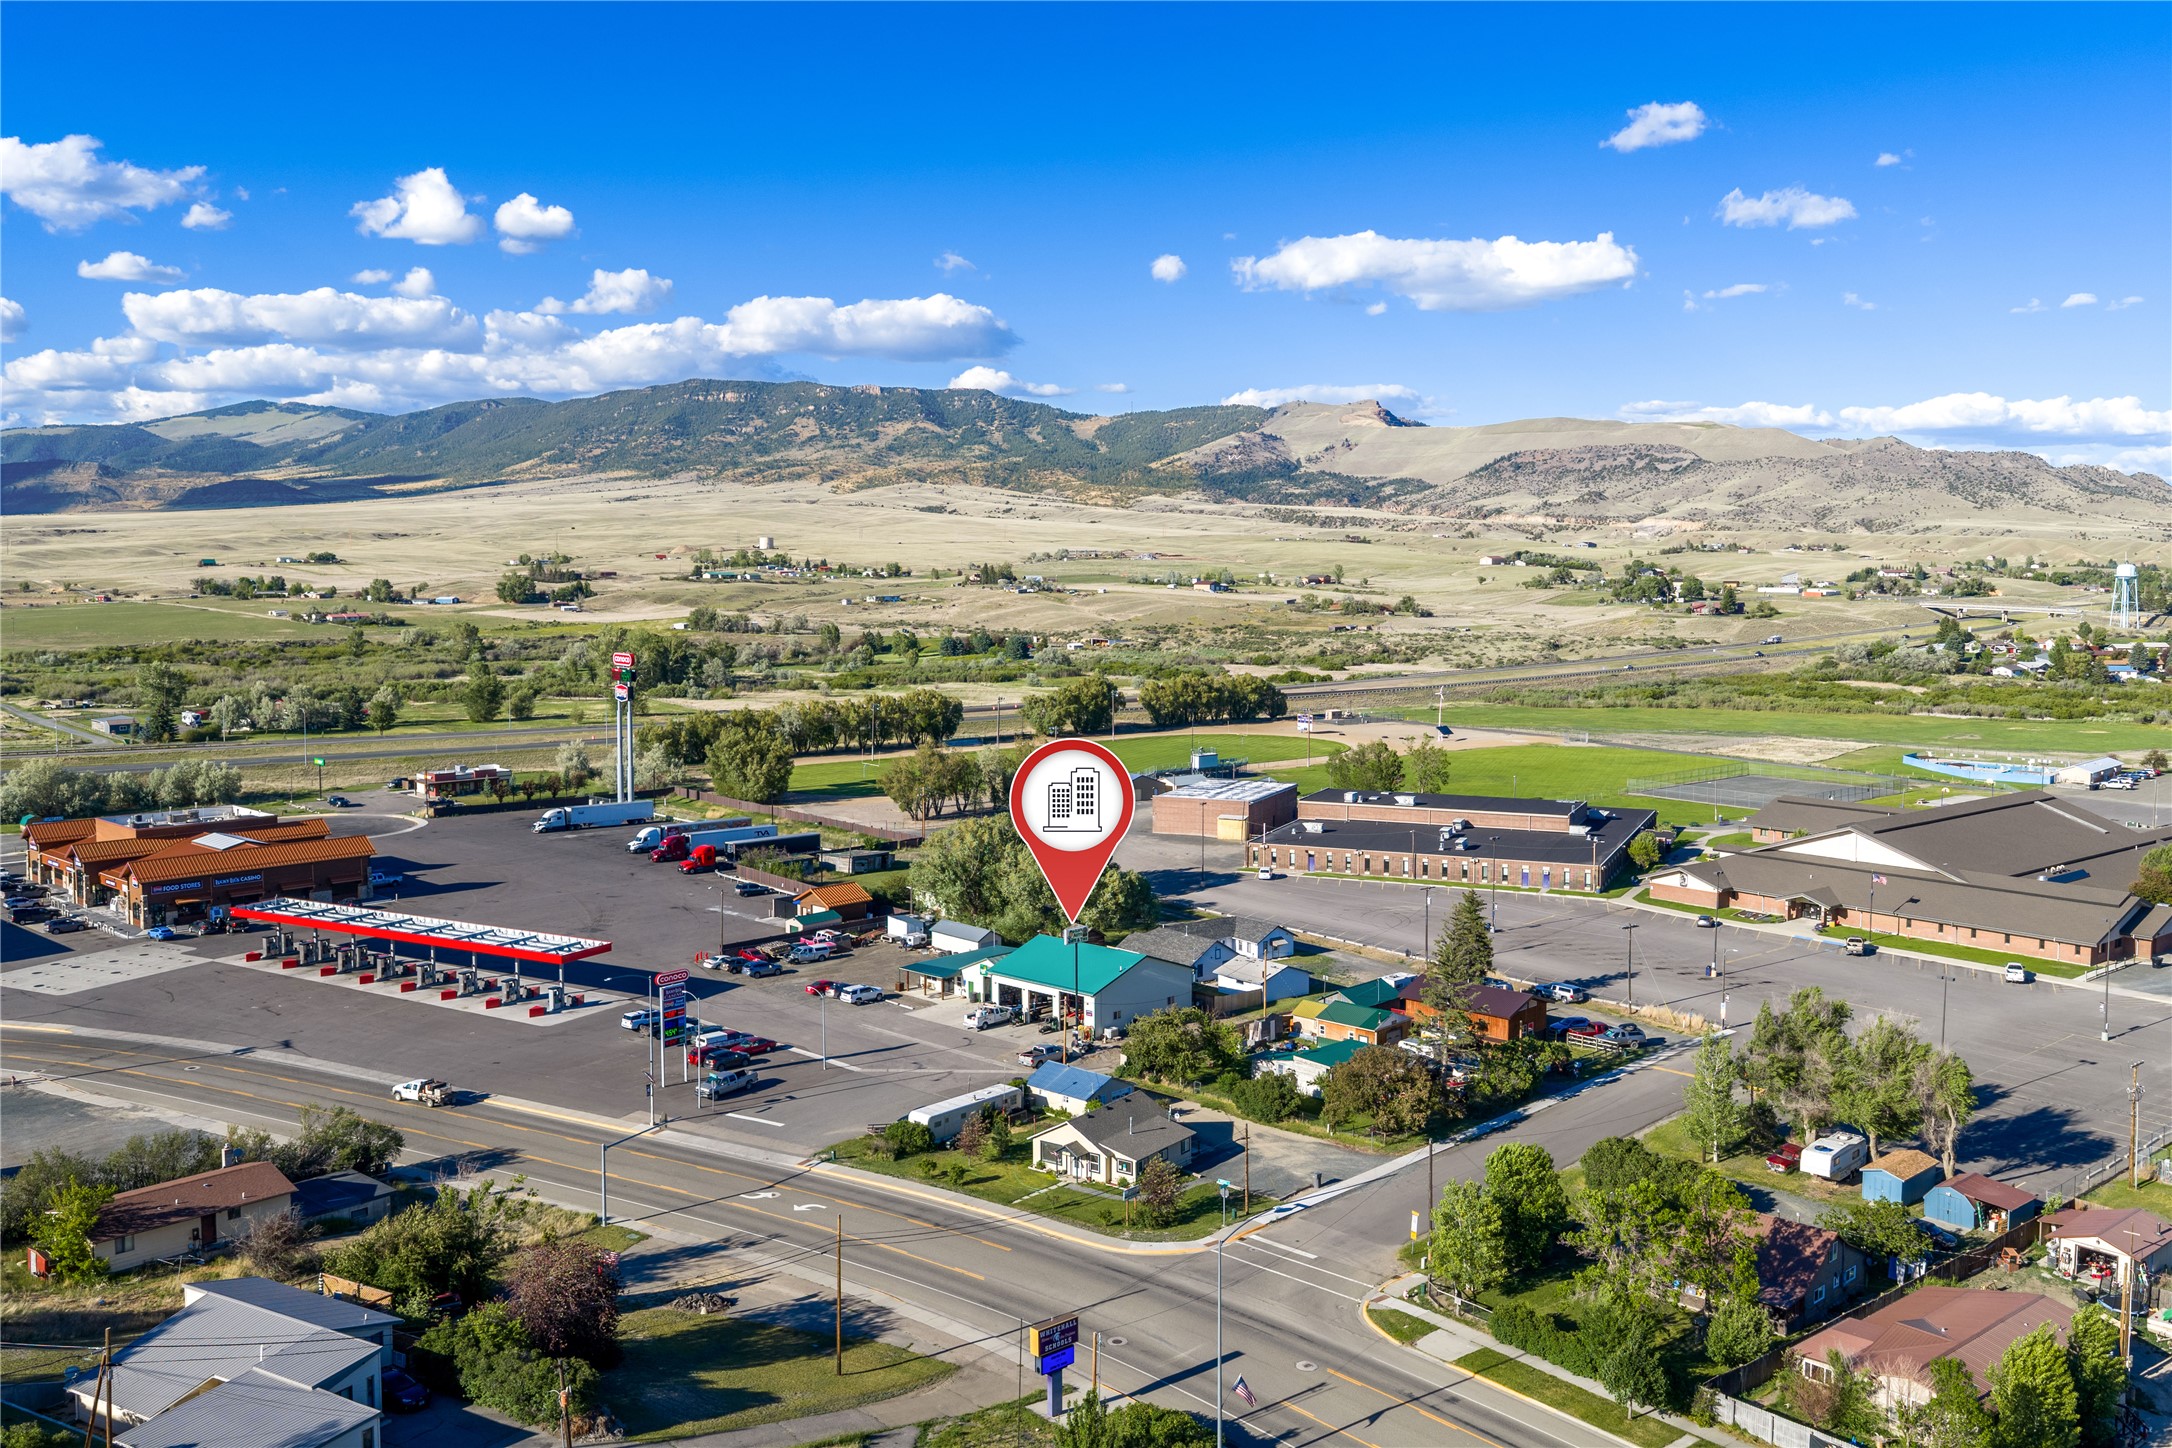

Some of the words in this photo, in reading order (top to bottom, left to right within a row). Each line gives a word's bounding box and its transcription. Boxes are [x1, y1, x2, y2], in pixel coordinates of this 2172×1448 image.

[240, 874, 261, 882] CASINO
[180, 881, 201, 890] STORES
[660, 972, 687, 983] conoco
[1040, 1320, 1077, 1338] WHITEHALL
[1044, 1337, 1072, 1352] SCHOOLS
